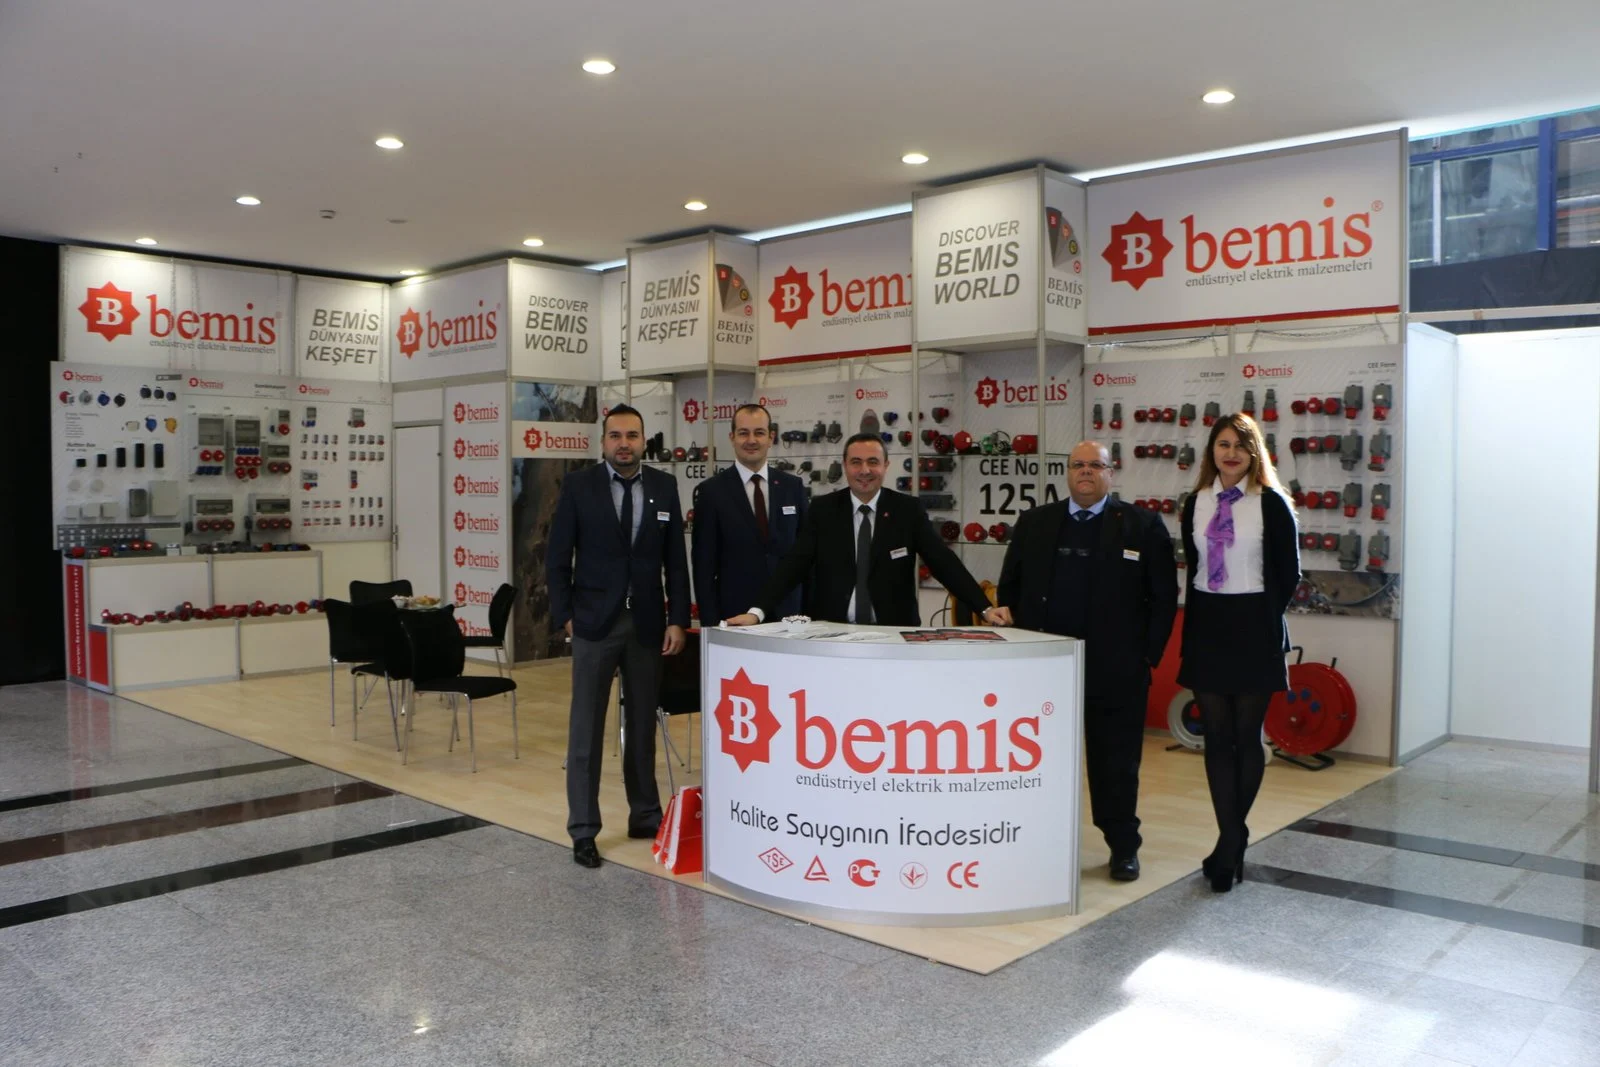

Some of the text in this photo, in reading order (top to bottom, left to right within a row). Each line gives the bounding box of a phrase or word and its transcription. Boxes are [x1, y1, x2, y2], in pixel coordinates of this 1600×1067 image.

[939, 220, 1020, 248] DISCOVER
[1180, 197, 1373, 274] bemis
[935, 241, 1020, 278] BEMIS
[1185, 259, 1373, 288] endüstriyel elektrik malzemeleri
[643, 270, 701, 302] BEMİS
[819, 268, 912, 316] bem
[934, 273, 1020, 305] WORLD
[1047, 276, 1083, 296] BEMİS
[528, 295, 589, 313] DISCOVER
[640, 299, 700, 320] DÜNYASINI
[1046, 292, 1082, 309] GRUP
[146, 294, 277, 345] bemis
[312, 308, 379, 331] BEMİS
[426, 300, 497, 349] bemis
[525, 311, 588, 334] BEMIS
[717, 318, 754, 334] BEMİS
[822, 311, 861, 328] endüstriyel
[863, 308, 893, 324] elektrik
[309, 329, 378, 346] DÜNYASINI
[637, 318, 698, 344] KEŞFET
[716, 332, 753, 346] GRUP
[524, 333, 588, 354] WORLD
[305, 345, 378, 366] KEŞFET
[1106, 373, 1136, 385] bemis
[1258, 364, 1293, 377] bemis
[865, 387, 889, 400] bemis
[467, 402, 499, 420] bemis
[467, 439, 499, 457] bemis
[545, 431, 590, 450] bemis
[686, 464, 706, 479] CEE
[980, 459, 1064, 475] CEE Nom
[467, 476, 499, 494] bemis
[467, 513, 499, 531] bemis
[467, 549, 499, 569] bemis
[788, 689, 1043, 775] bemis
[796, 772, 1043, 794] endüstriyel elektrik malzemeleri
[730, 799, 1021, 847] Kalite Saygının İfadesidir
[766, 852, 785, 869] TSE
[946, 861, 979, 889] CE
